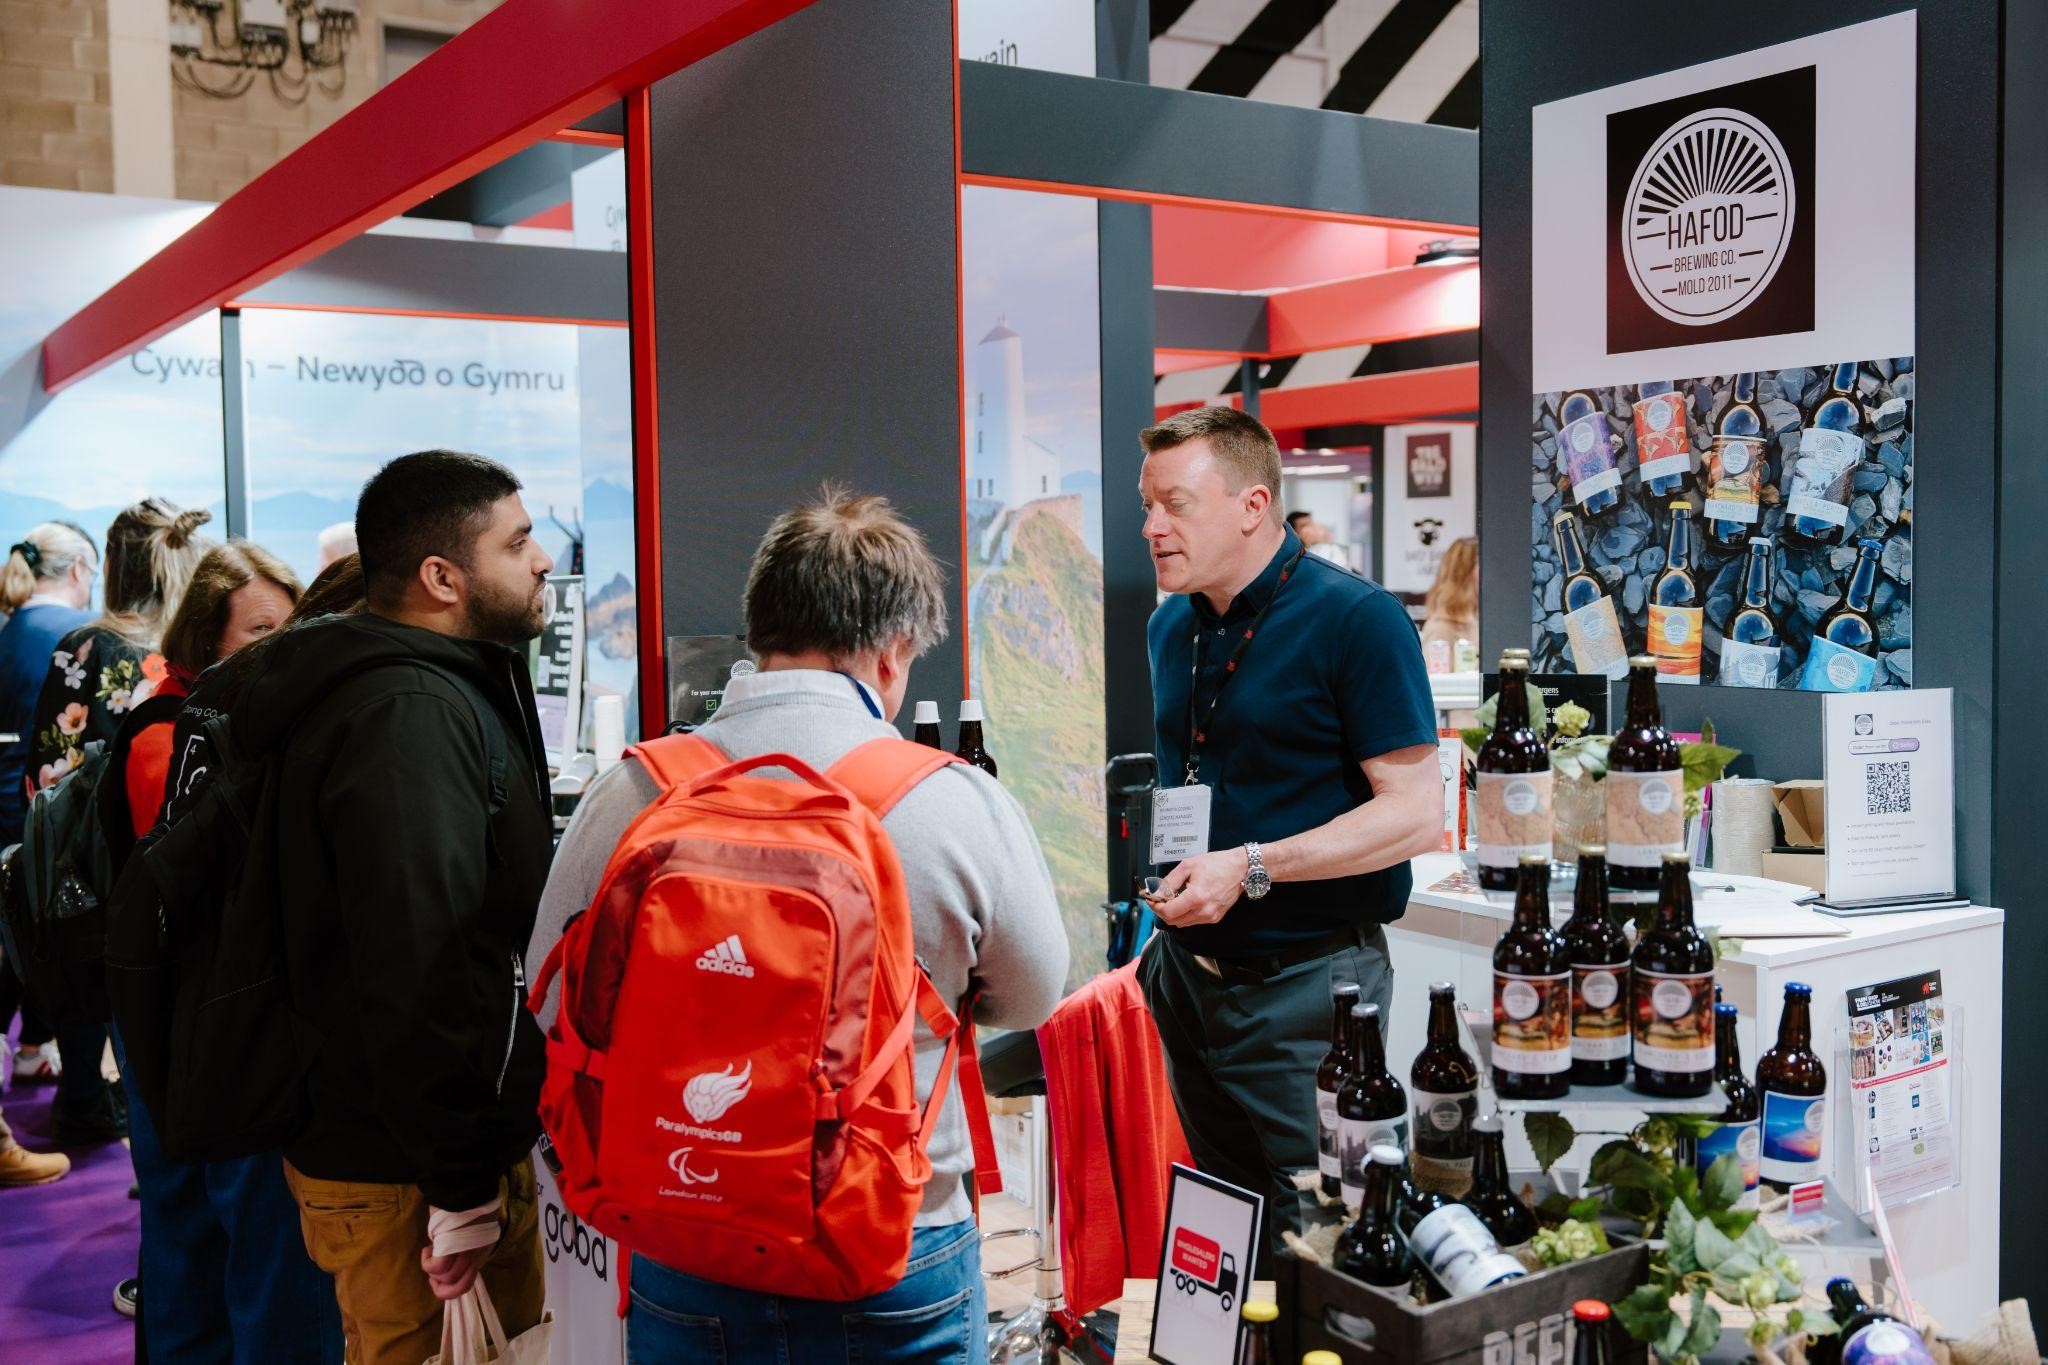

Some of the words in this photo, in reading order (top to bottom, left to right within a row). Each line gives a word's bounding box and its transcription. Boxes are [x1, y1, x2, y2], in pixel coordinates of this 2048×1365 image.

[1668, 203, 1744, 250] HAFOD
[1674, 252, 1718, 273] BREWING
[1720, 249, 1736, 266] CO.
[1678, 277, 1705, 296] MOLD
[1708, 274, 1732, 293] 2011
[436, 366, 454, 386] o
[463, 362, 565, 395] Gymru
[696, 956, 755, 979] adidas
[656, 1116, 742, 1144] ParalympicsGB
[658, 1185, 698, 1200] London
[700, 1192, 724, 1203] 2012
[1182, 1252, 1208, 1270] WANTED
